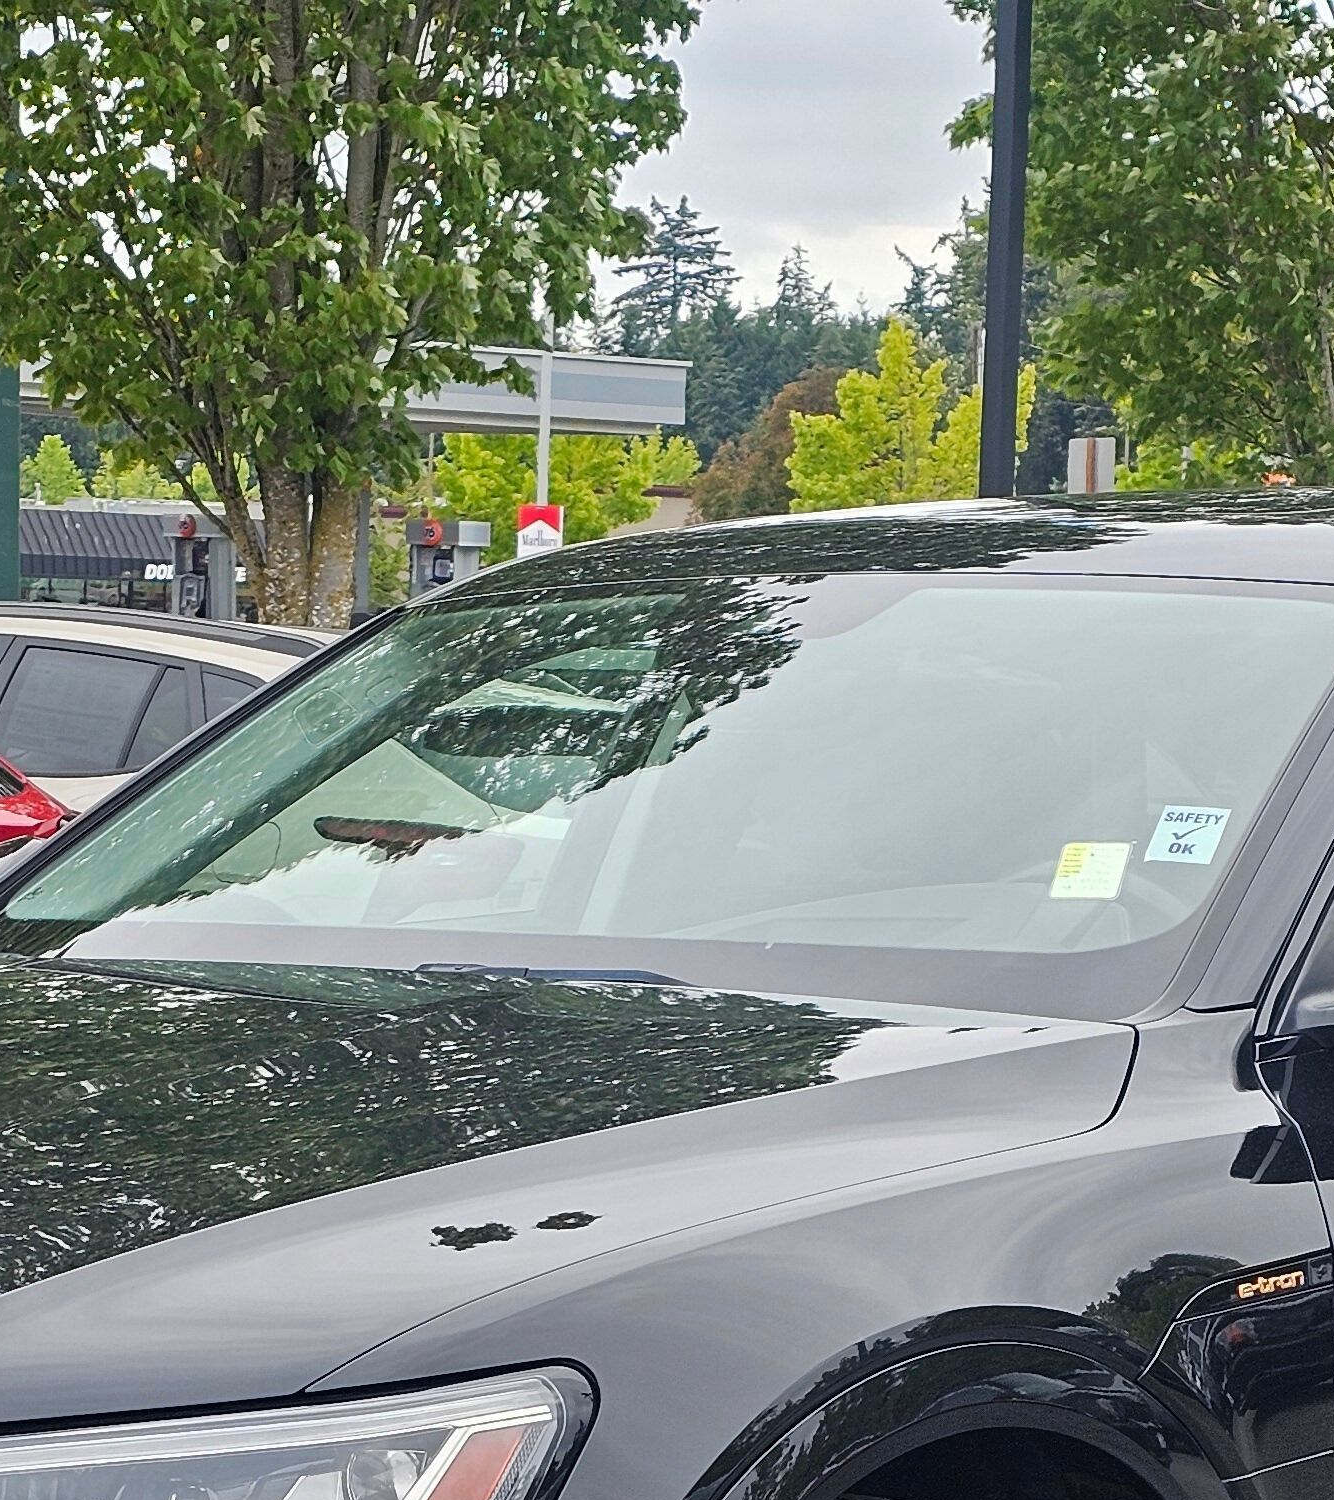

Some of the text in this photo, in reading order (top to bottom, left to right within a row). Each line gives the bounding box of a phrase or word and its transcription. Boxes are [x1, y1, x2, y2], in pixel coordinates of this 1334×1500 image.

[1164, 811, 1224, 825] SAFETY
[1168, 842, 1197, 855] OK
[1238, 1270, 1305, 1299] e-tron
